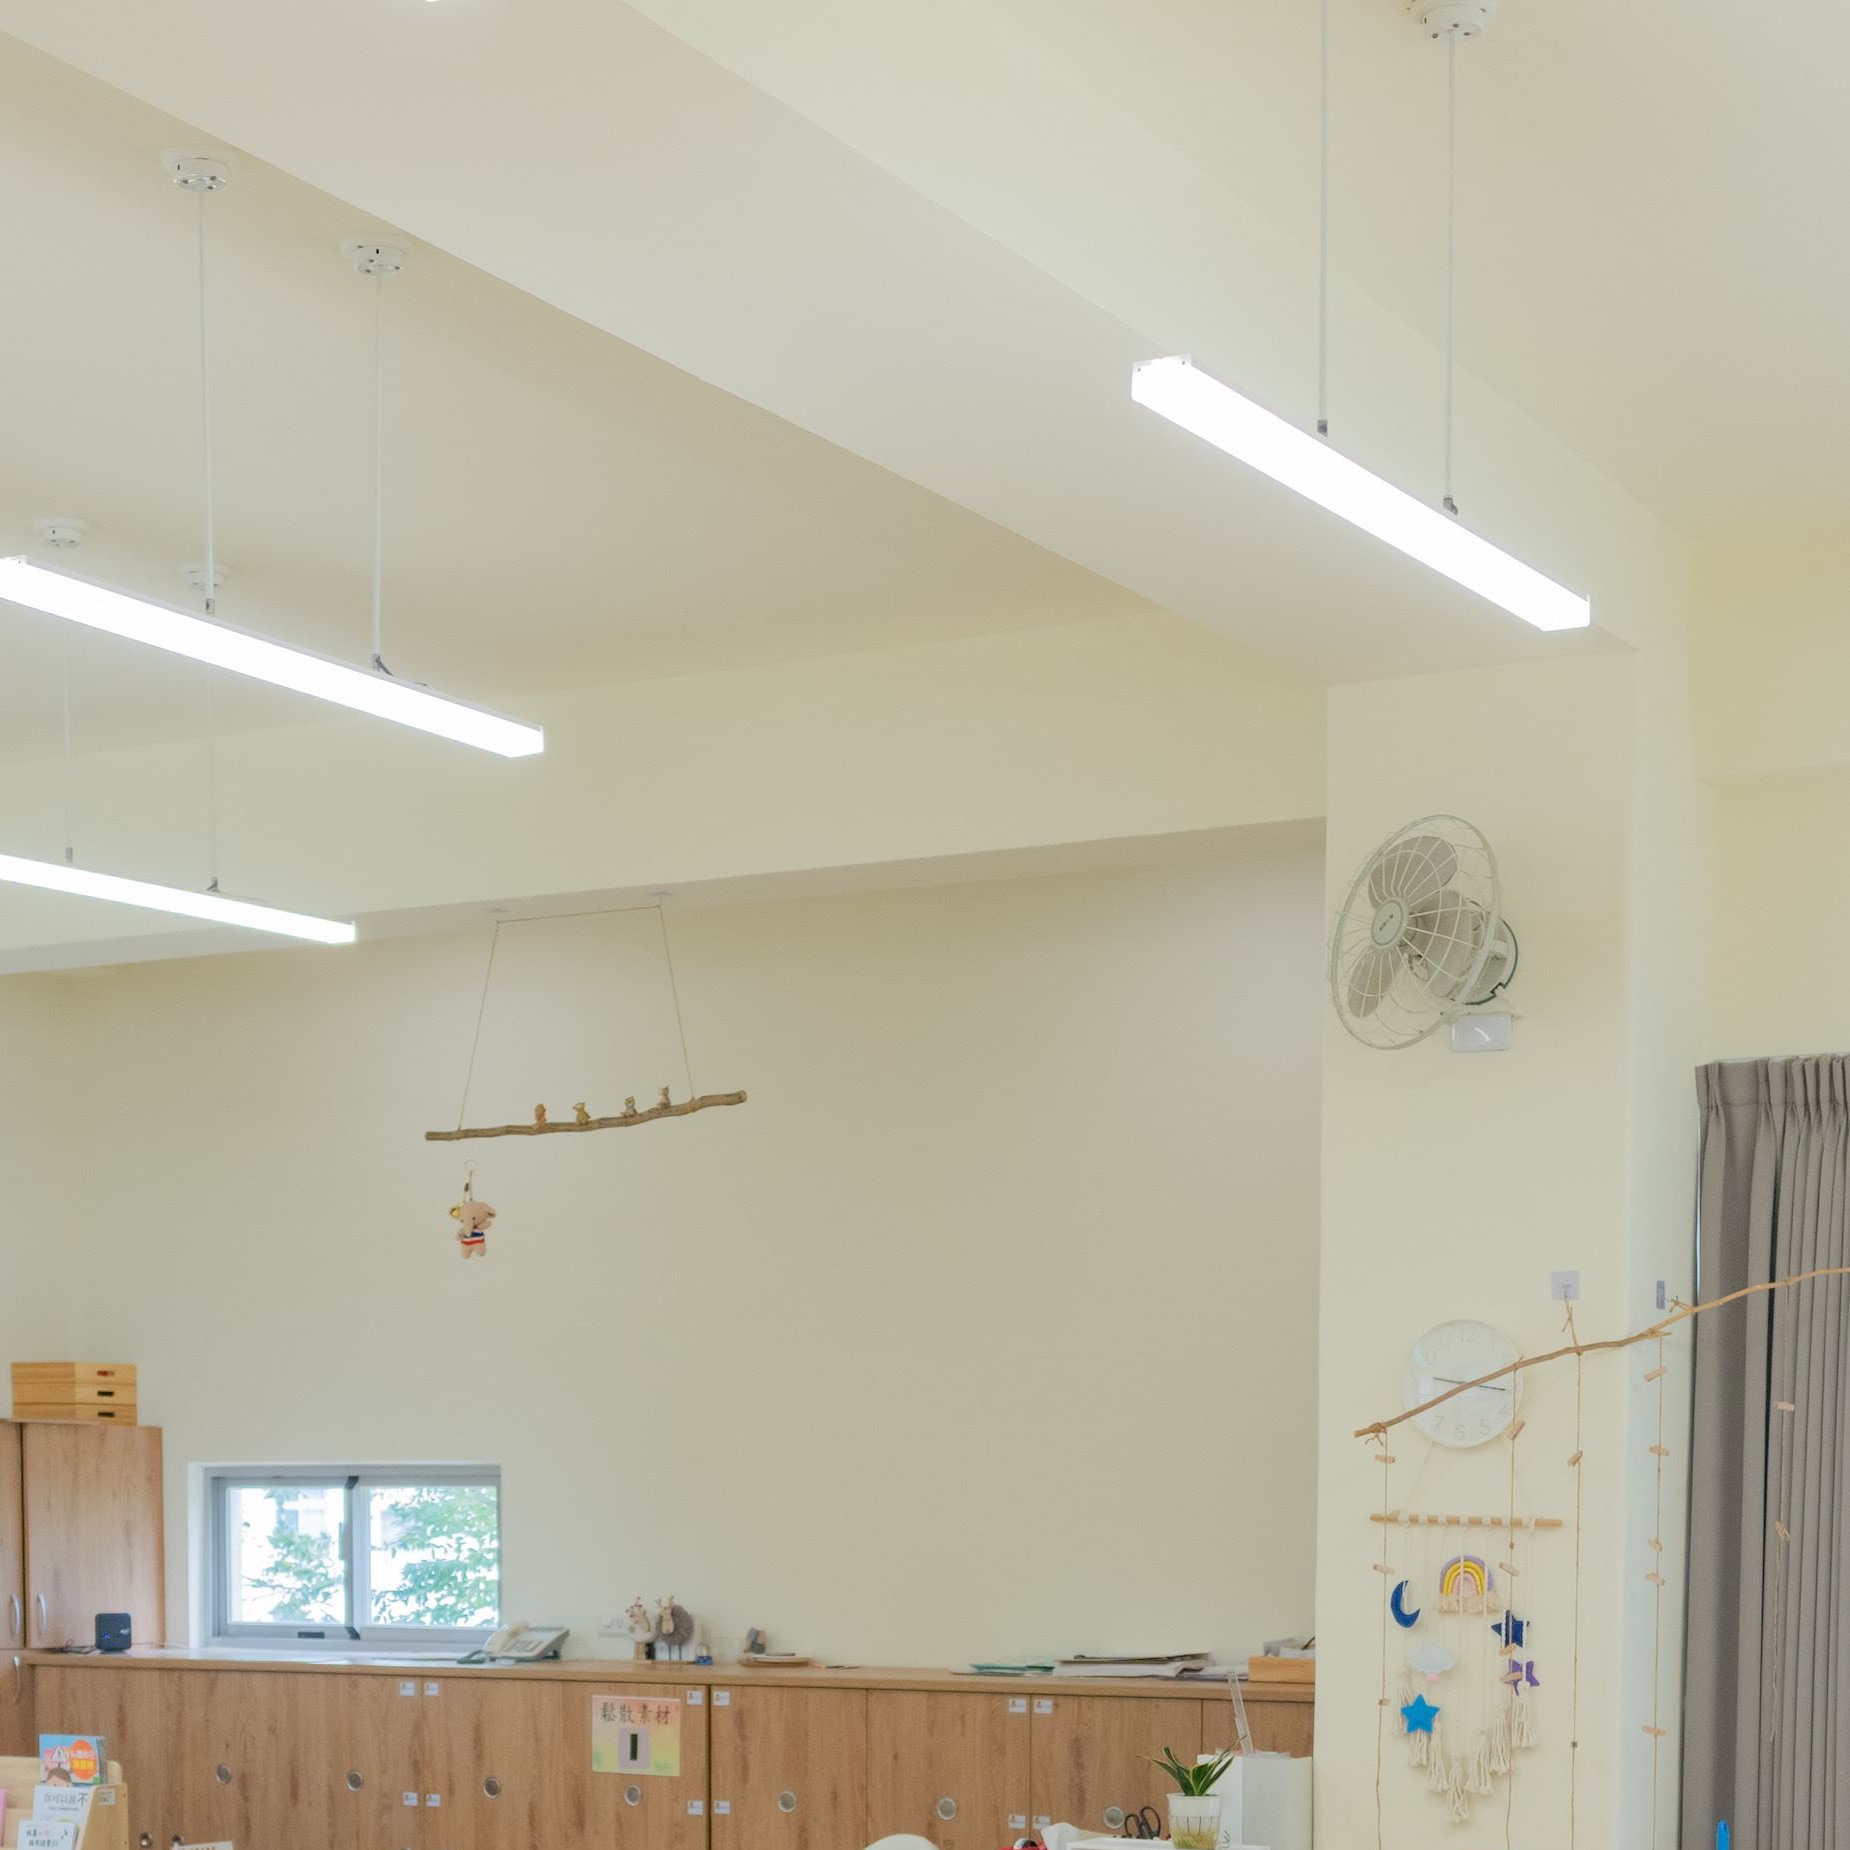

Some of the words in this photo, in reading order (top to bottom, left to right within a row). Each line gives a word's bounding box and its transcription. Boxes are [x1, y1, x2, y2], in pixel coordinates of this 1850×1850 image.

[1454, 1424, 1466, 1440] 6
[600, 1702, 671, 1725] 鬆散素材
